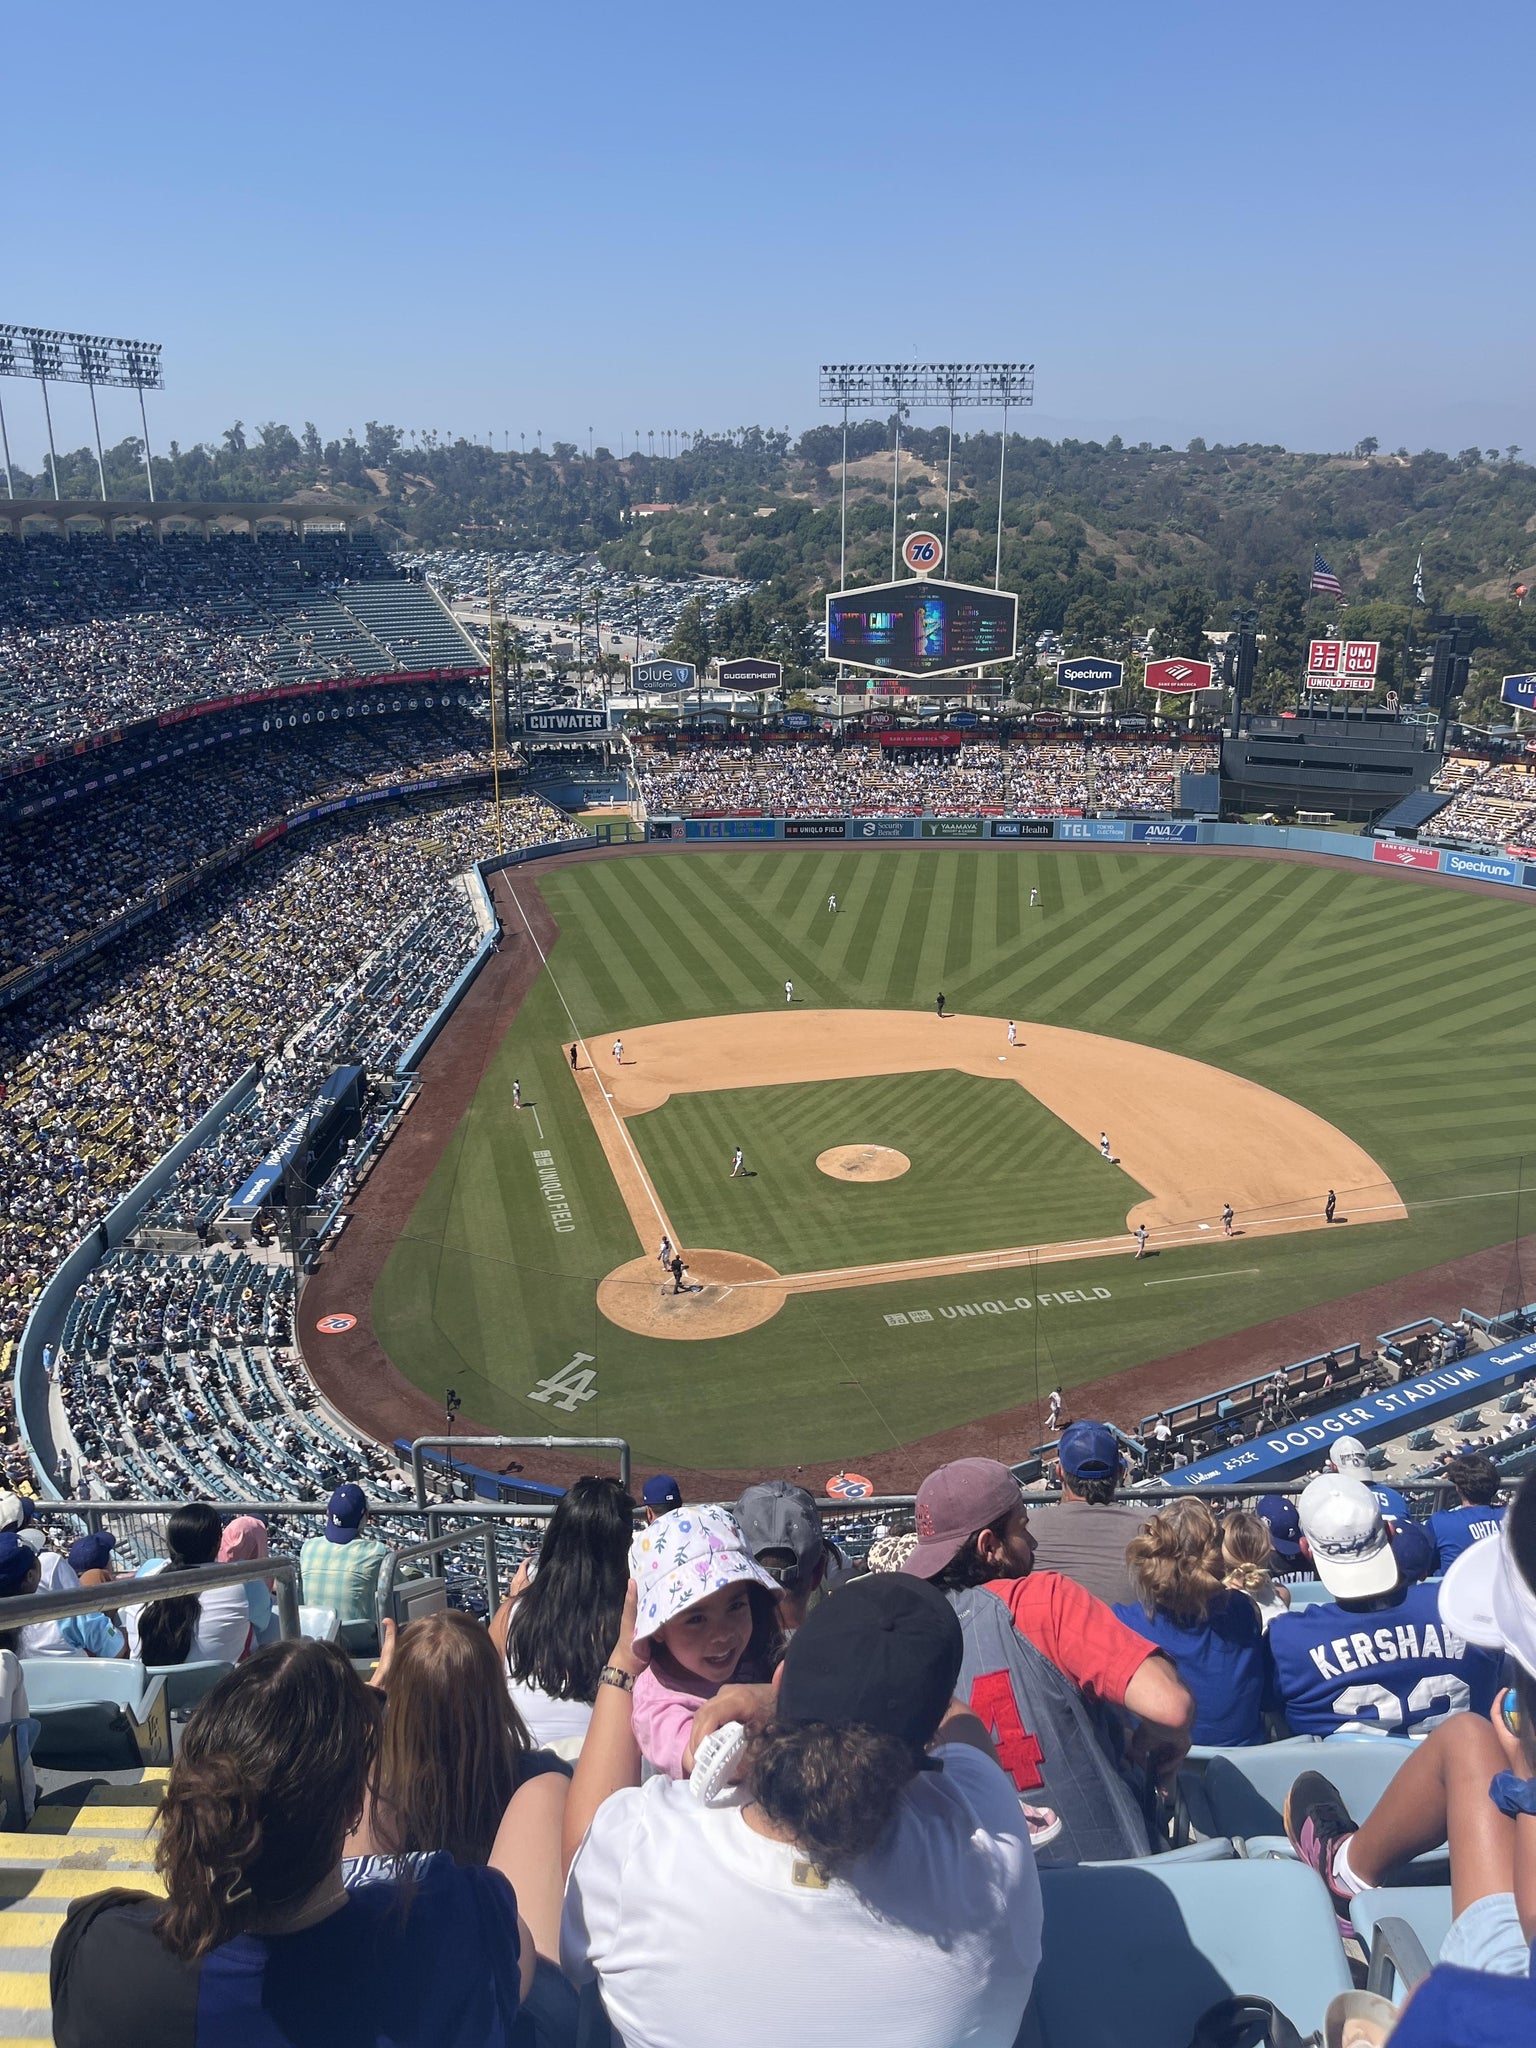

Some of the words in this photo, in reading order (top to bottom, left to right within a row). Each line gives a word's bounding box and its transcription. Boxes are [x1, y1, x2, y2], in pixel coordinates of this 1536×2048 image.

[911, 542, 934, 561] 76
[1350, 646, 1372, 658] UNI
[1348, 658, 1372, 670] QLO
[638, 667, 673, 681] blue
[724, 672, 777, 680] GUGGENHEIM
[1064, 669, 1112, 681] Spectrum
[1310, 679, 1342, 688] UNIQLO
[1343, 680, 1370, 689] FIELD
[530, 714, 602, 729] CUTWATER
[870, 715, 890, 724] JINRO
[878, 822, 904, 830] Security
[1022, 826, 1048, 834] Health
[1062, 824, 1091, 836] TEL
[1146, 825, 1171, 835] ANA
[1406, 847, 1434, 856] AMERICA
[1450, 856, 1506, 876] Spectrum
[538, 1167, 566, 1202] UNIQLO
[548, 1202, 576, 1233] FIELD
[938, 1297, 1032, 1319] UNIQLO
[1036, 1287, 1112, 1306] FIELD
[326, 1318, 353, 1330] 76
[527, 1352, 599, 1412] LA
[1266, 1408, 1376, 1454] DODGER
[1376, 1367, 1481, 1412] STADIUM
[1222, 1452, 1260, 1470] ようこそ
[1184, 1470, 1222, 1484] Welcome
[832, 1478, 868, 1499] 76
[1309, 1623, 1468, 1680] KERSHAW
